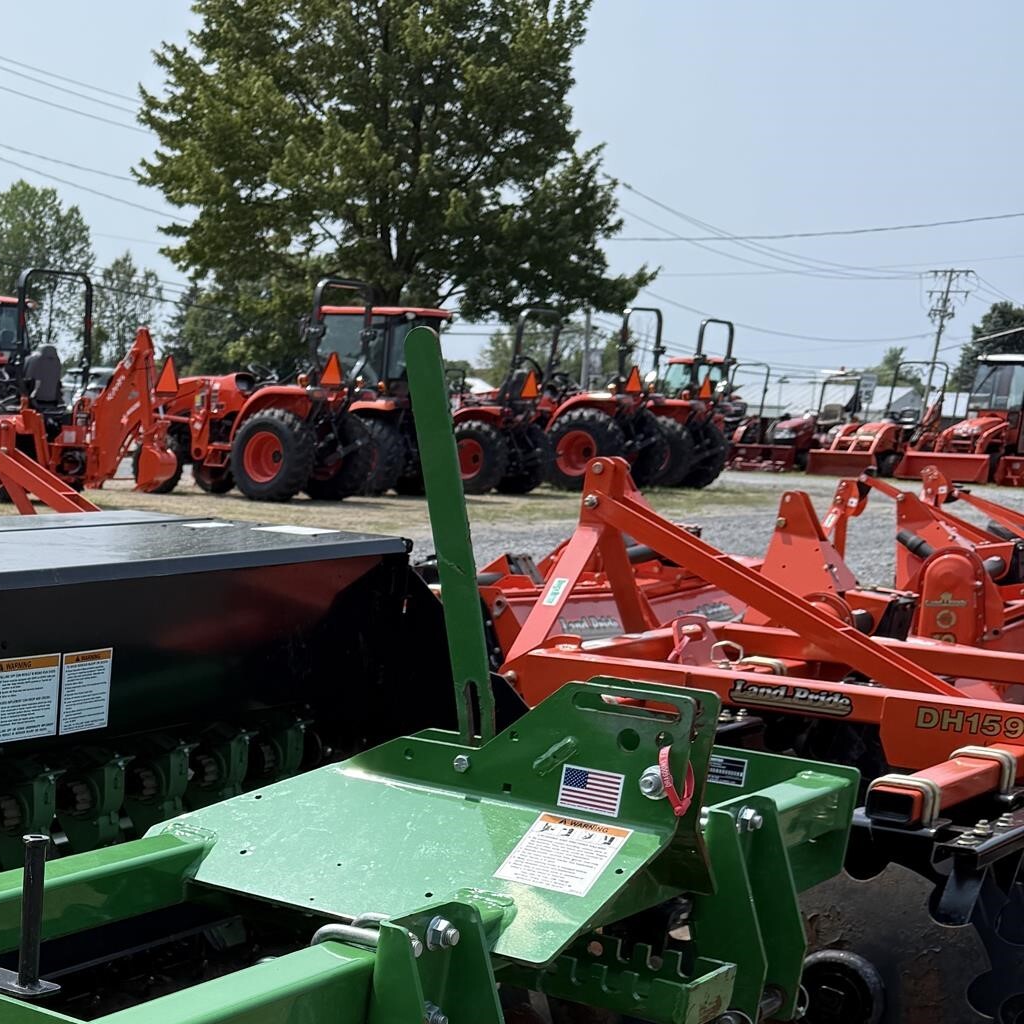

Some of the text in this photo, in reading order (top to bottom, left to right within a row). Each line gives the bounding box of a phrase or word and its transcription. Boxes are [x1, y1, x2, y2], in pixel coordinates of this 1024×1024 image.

[6, 661, 33, 670] WARNING
[733, 679, 851, 706] Land Pride
[916, 706, 1024, 739] DH159
[570, 820, 609, 833] WARNING
